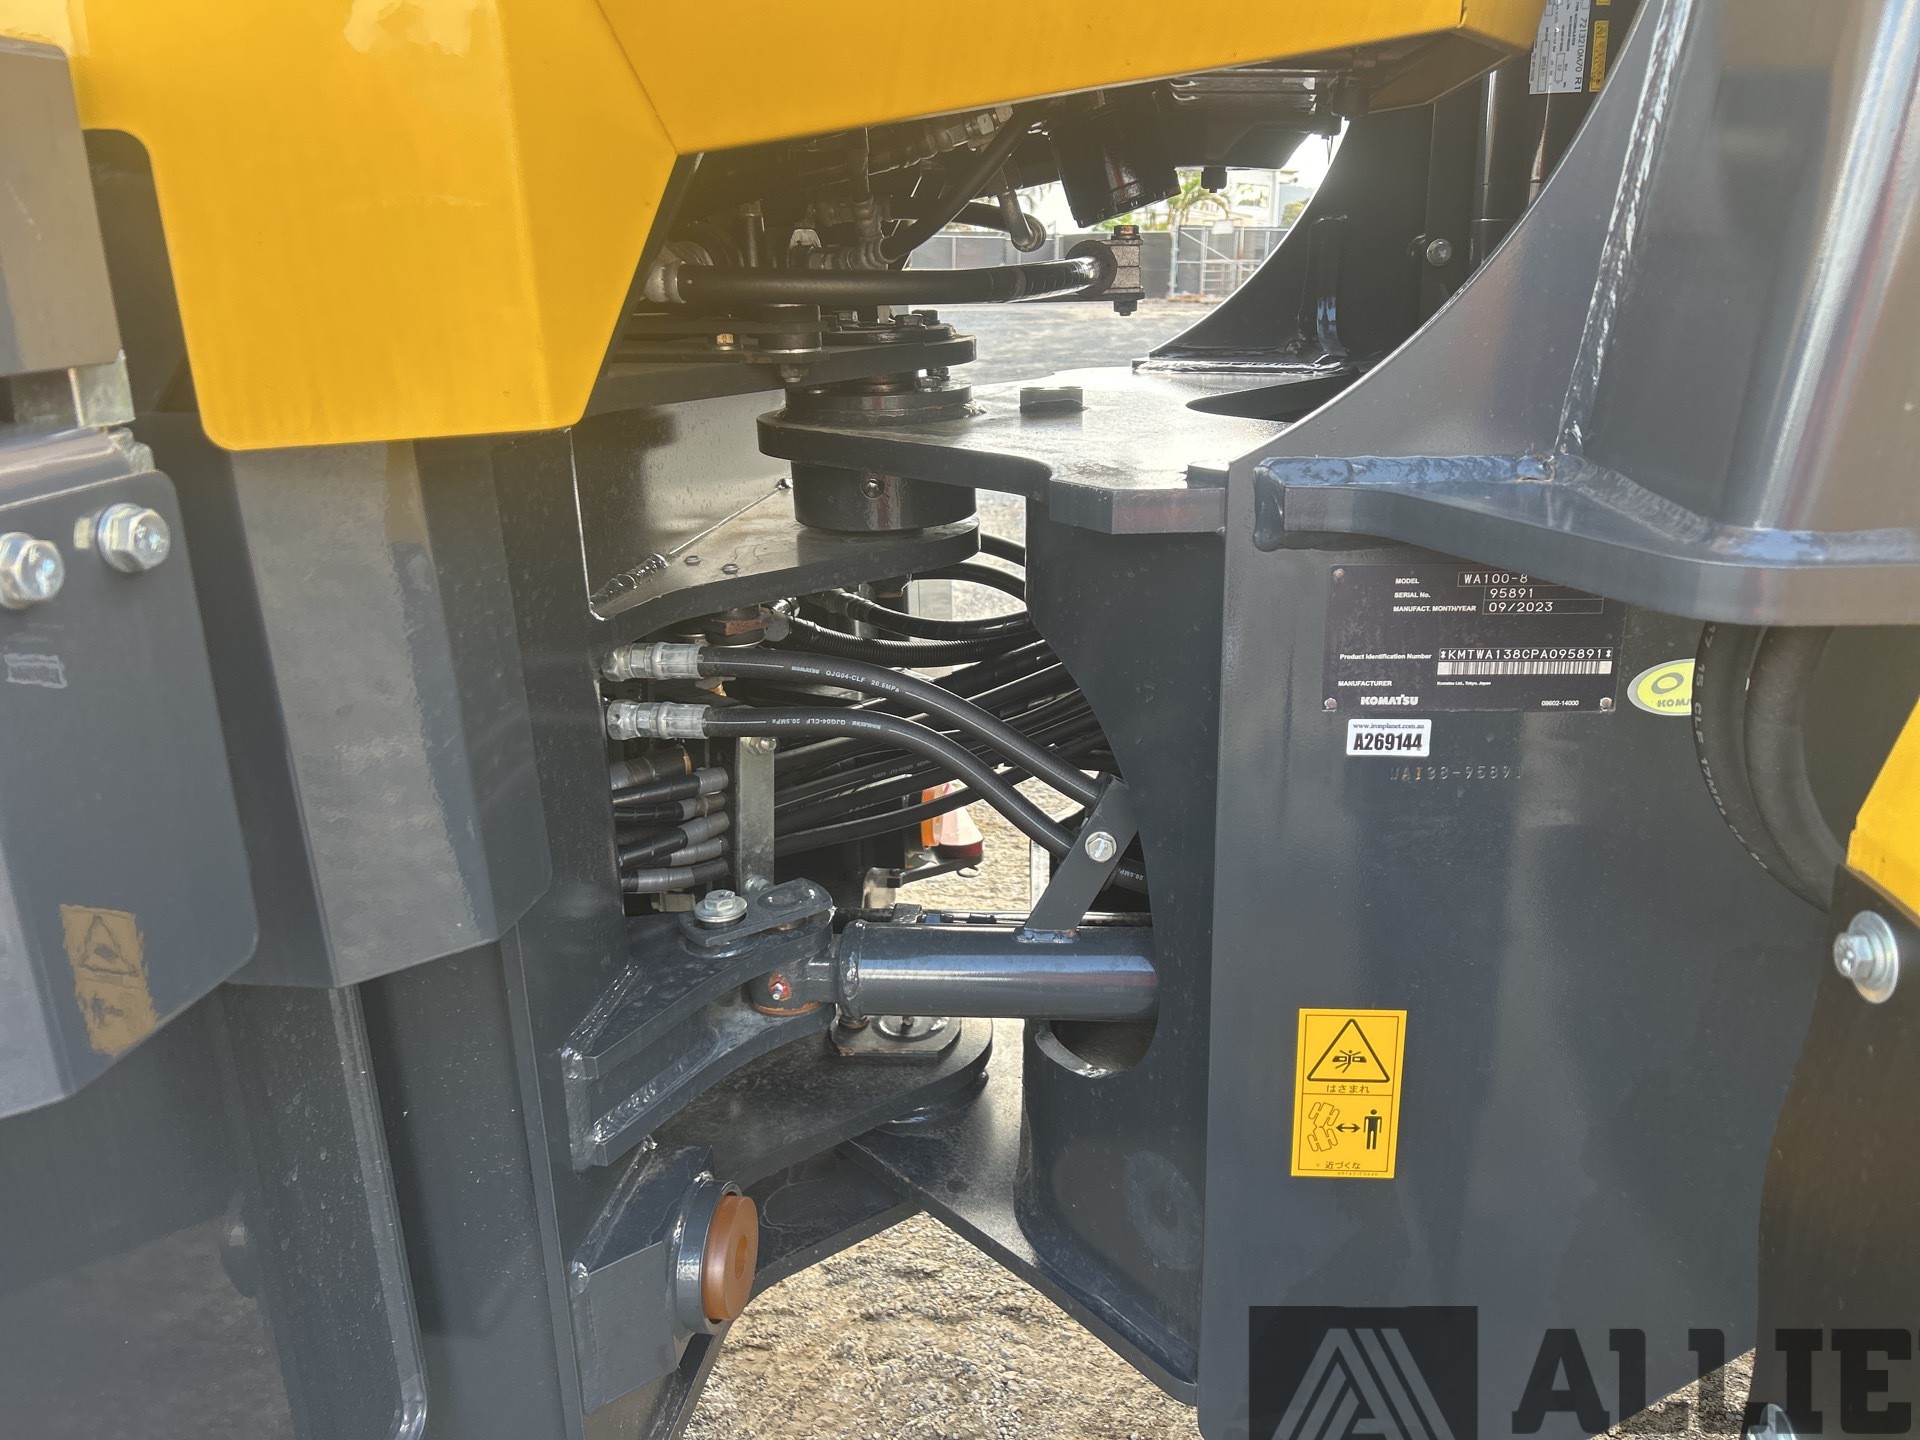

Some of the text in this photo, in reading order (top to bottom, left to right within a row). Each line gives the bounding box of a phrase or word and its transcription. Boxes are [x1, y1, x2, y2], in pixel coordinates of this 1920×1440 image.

[1574, 76, 1582, 90] R1
[1464, 573, 1528, 584] WA100-8
[1490, 588, 1534, 598] 95891
[1488, 601, 1553, 613] 09/2023
[1360, 694, 1418, 706] KOMATSU
[1353, 722, 1425, 730] www.ironplanet.com.au
[1694, 702, 1704, 743] CLF
[1353, 733, 1422, 750] A269144
[1326, 1084, 1370, 1093] はさまれ
[1325, 1161, 1361, 1169] 近づくな
